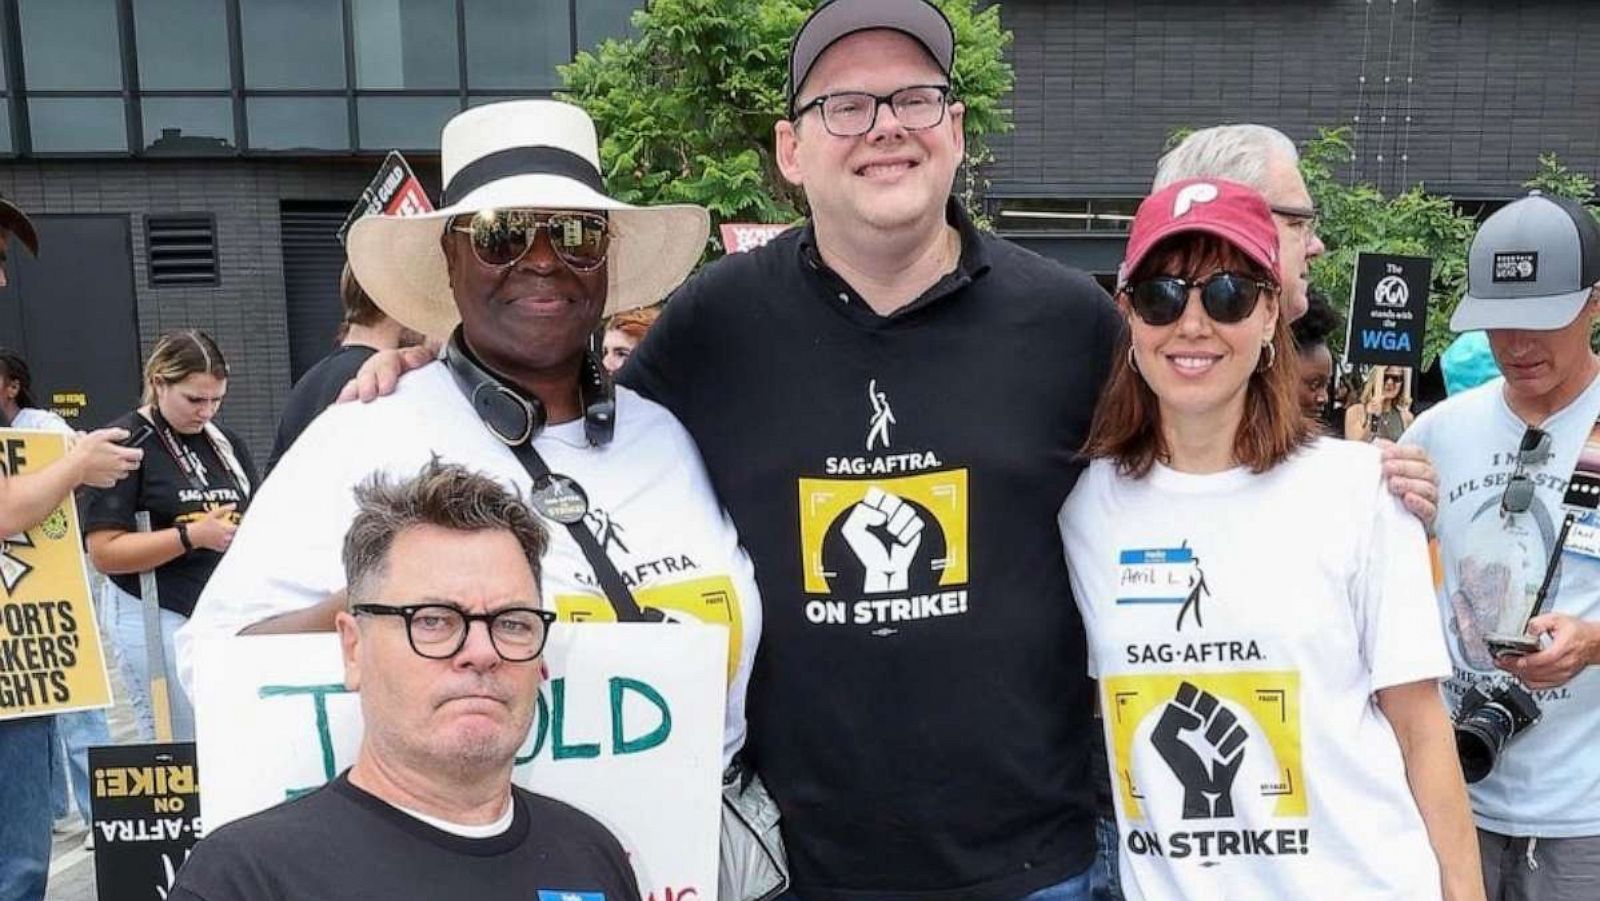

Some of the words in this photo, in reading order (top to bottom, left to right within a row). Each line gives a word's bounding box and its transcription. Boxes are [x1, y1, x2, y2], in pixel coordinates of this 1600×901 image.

[1173, 182, 1218, 219] P
[1385, 263, 1403, 274] The
[1363, 328, 1411, 352] WGA
[0, 601, 76, 635] ORTS
[806, 600, 846, 624] ON
[853, 591, 968, 624] STRIKE!
[0, 635, 79, 672] KERS'
[0, 671, 70, 707] GHTS
[514, 676, 672, 765] OLD
[154, 797, 185, 814] ON
[1127, 829, 1163, 857] ON
[1168, 829, 1310, 859] STRIKE!
